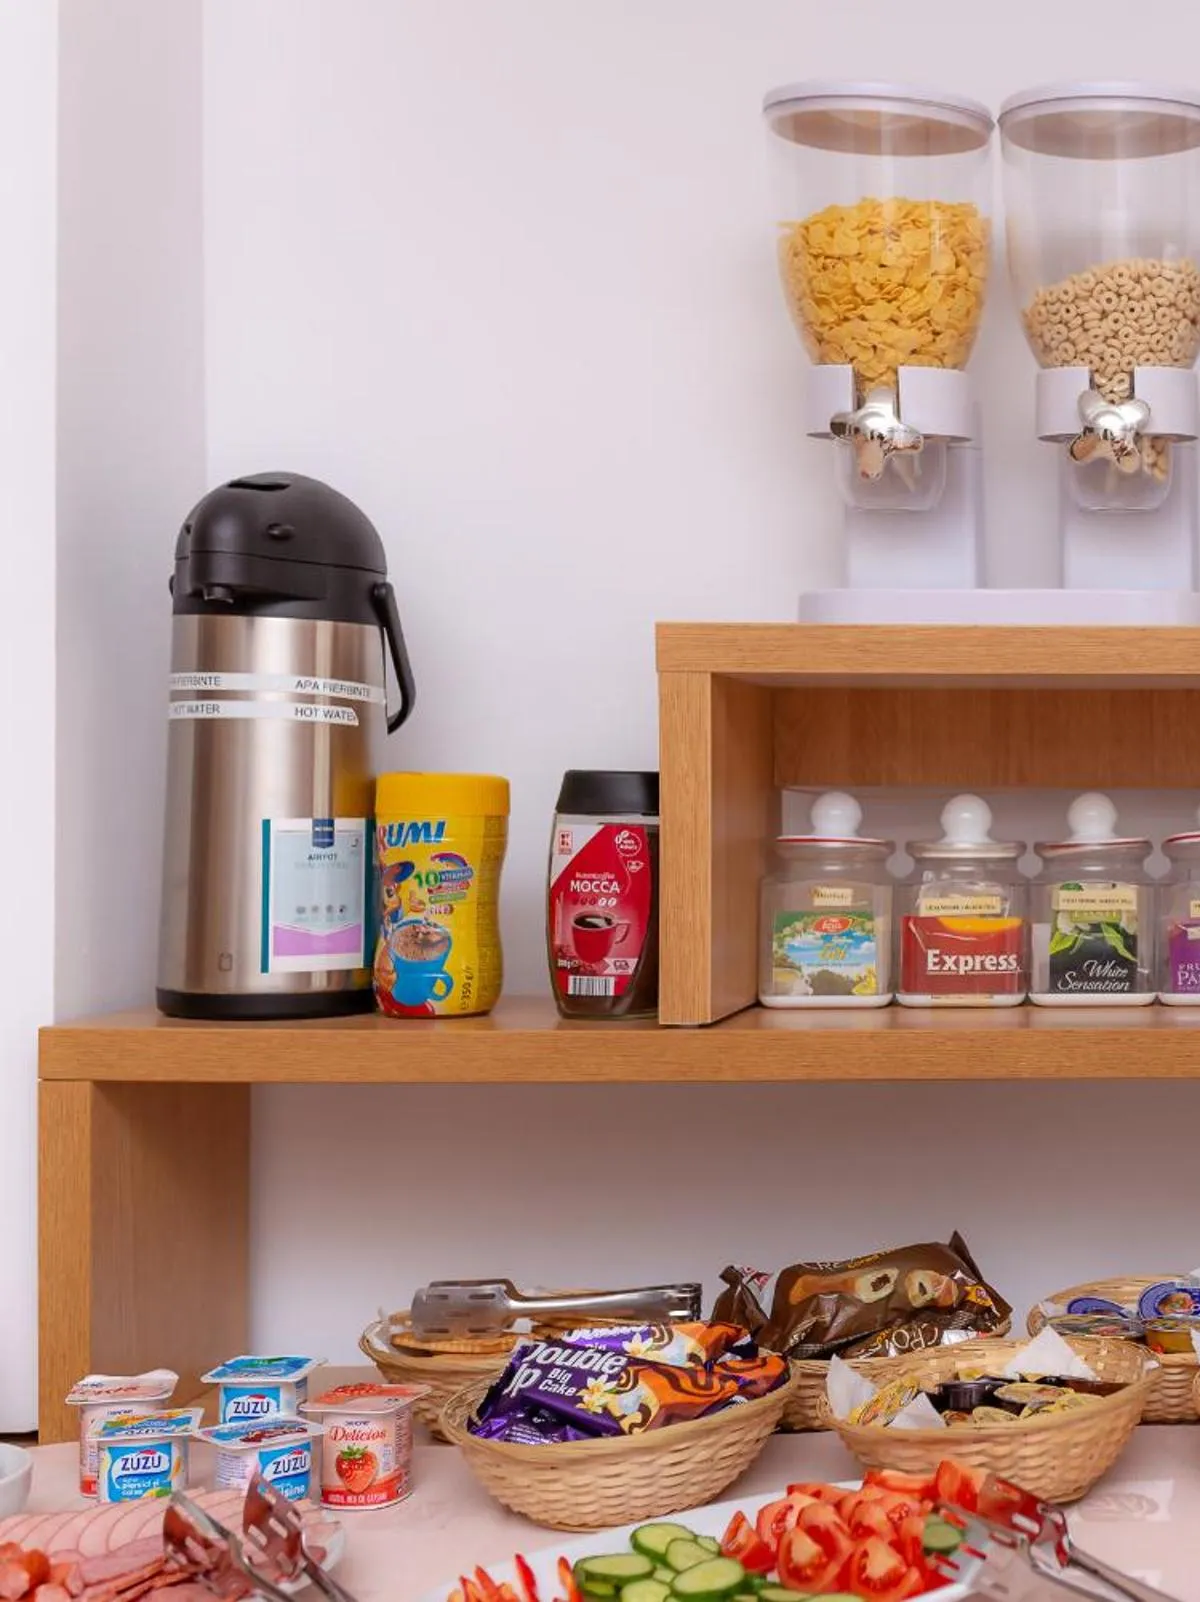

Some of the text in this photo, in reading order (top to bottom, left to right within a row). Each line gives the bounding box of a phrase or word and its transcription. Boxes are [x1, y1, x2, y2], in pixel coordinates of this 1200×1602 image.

[295, 679, 320, 690] APA
[295, 706, 320, 718] HOT
[570, 879, 620, 894] MOCCA
[927, 949, 1018, 975] Express
[1083, 959, 1129, 978] White
[1057, 970, 1131, 992] Sensation
[548, 1367, 573, 1382] Big
[538, 1379, 577, 1397] Cake
[232, 1400, 271, 1415] ZUZU
[329, 1426, 387, 1441] Delicios
[121, 1455, 162, 1472] ZUZU
[272, 1455, 307, 1475] ZUZU
